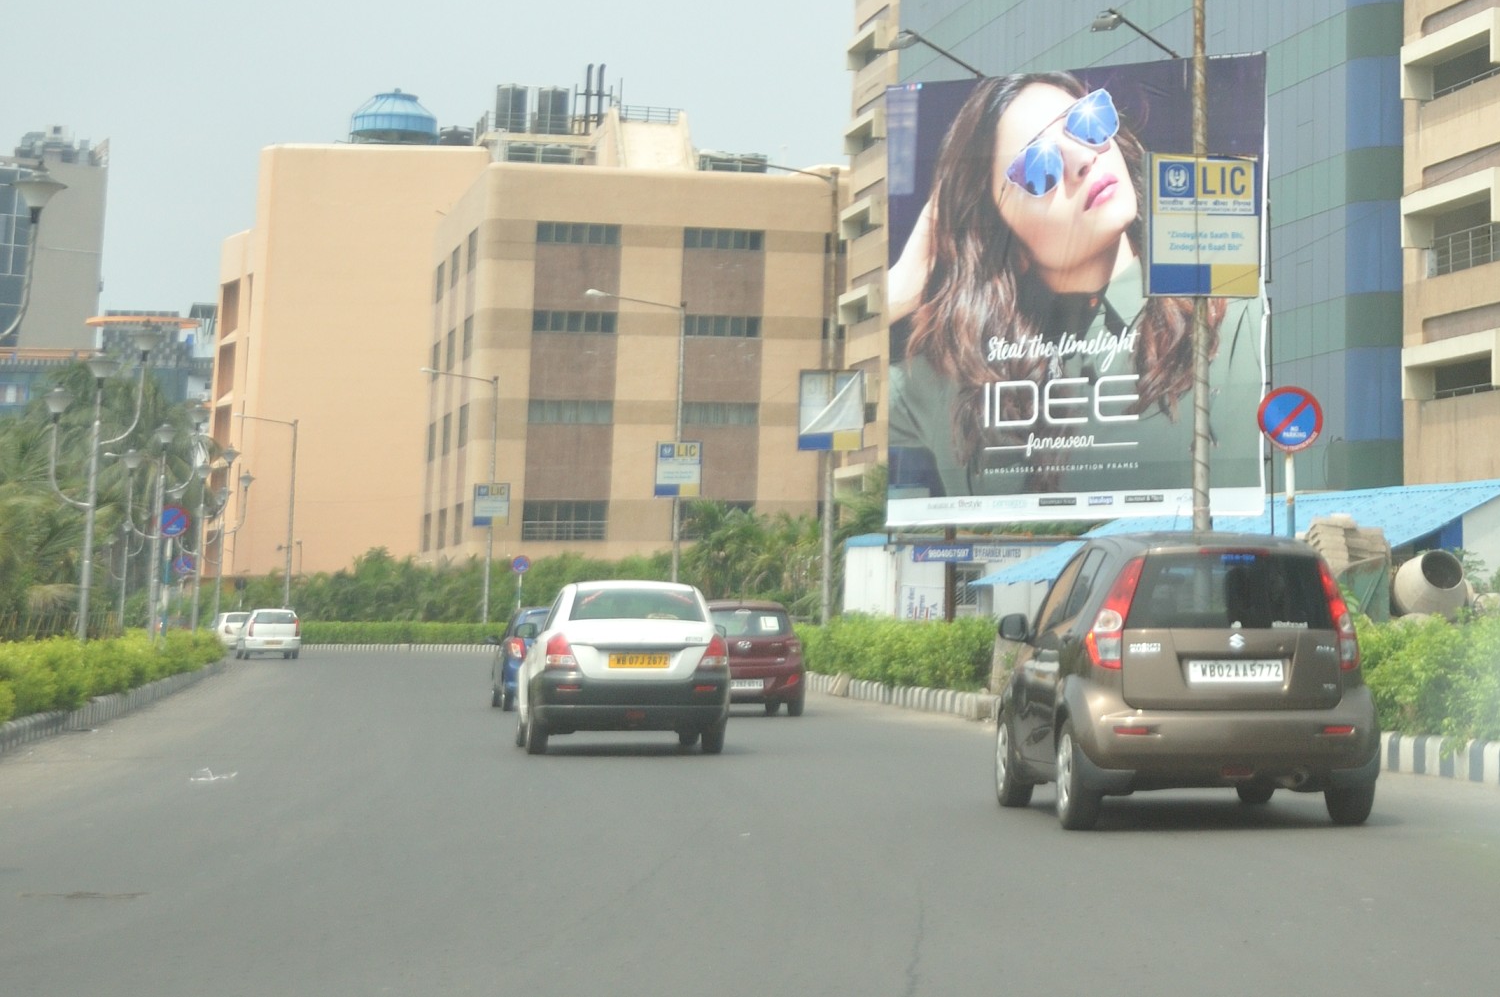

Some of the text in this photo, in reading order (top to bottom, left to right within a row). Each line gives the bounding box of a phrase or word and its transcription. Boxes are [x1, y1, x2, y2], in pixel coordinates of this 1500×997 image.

[1202, 166, 1246, 196] LIC
[987, 326, 1141, 373] Steal the limelight
[983, 374, 1140, 428] IDEE
[677, 444, 697, 457] LIC
[1026, 432, 1095, 457] famewear
[984, 465, 1034, 475] SUNGLASSES
[1046, 463, 1104, 472] PRESCRIPTION
[1201, 663, 1281, 678] WB02AA5772
